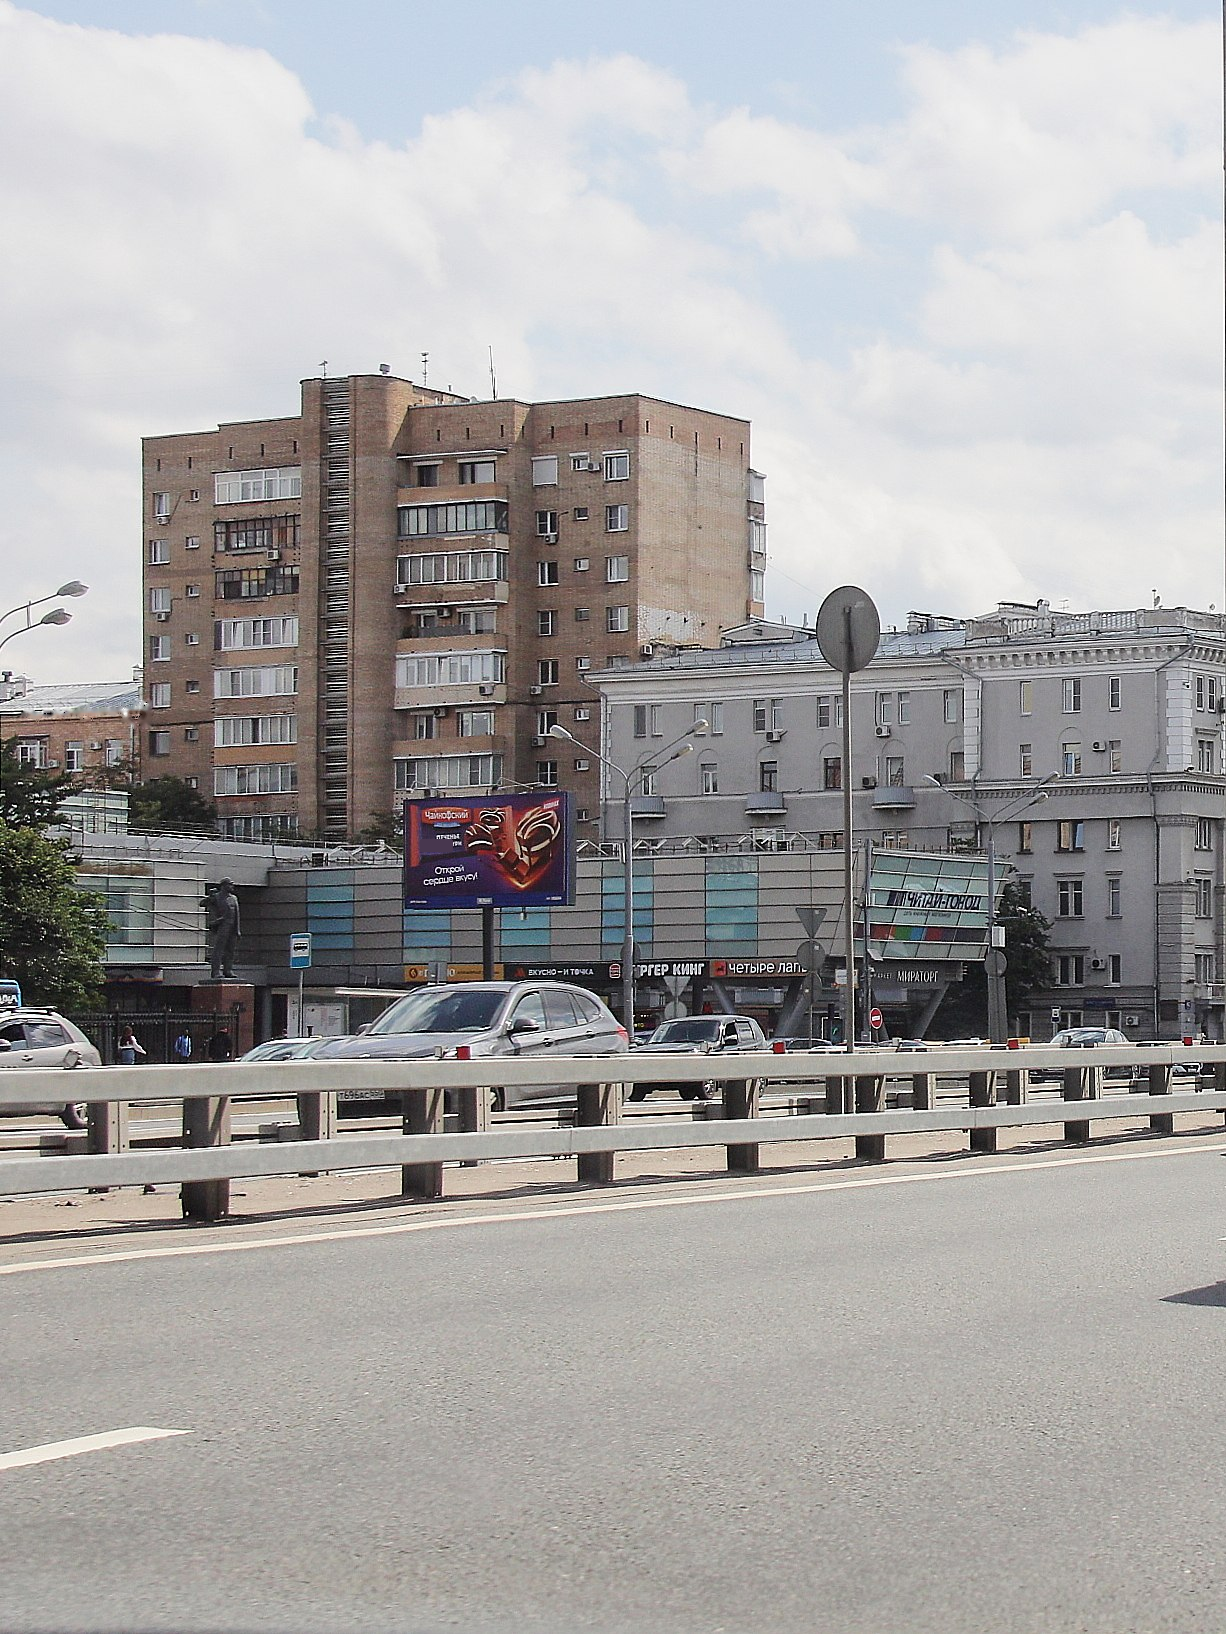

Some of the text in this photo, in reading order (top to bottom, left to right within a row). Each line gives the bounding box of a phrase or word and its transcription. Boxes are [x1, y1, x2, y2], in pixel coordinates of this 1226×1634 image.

[434, 864, 465, 875] Открой
[423, 876, 454, 887] сердце
[632, 963, 705, 976] РГЕР КИНГ
[729, 962, 775, 976] четыре
[897, 970, 939, 982] МИРАТОРГ
